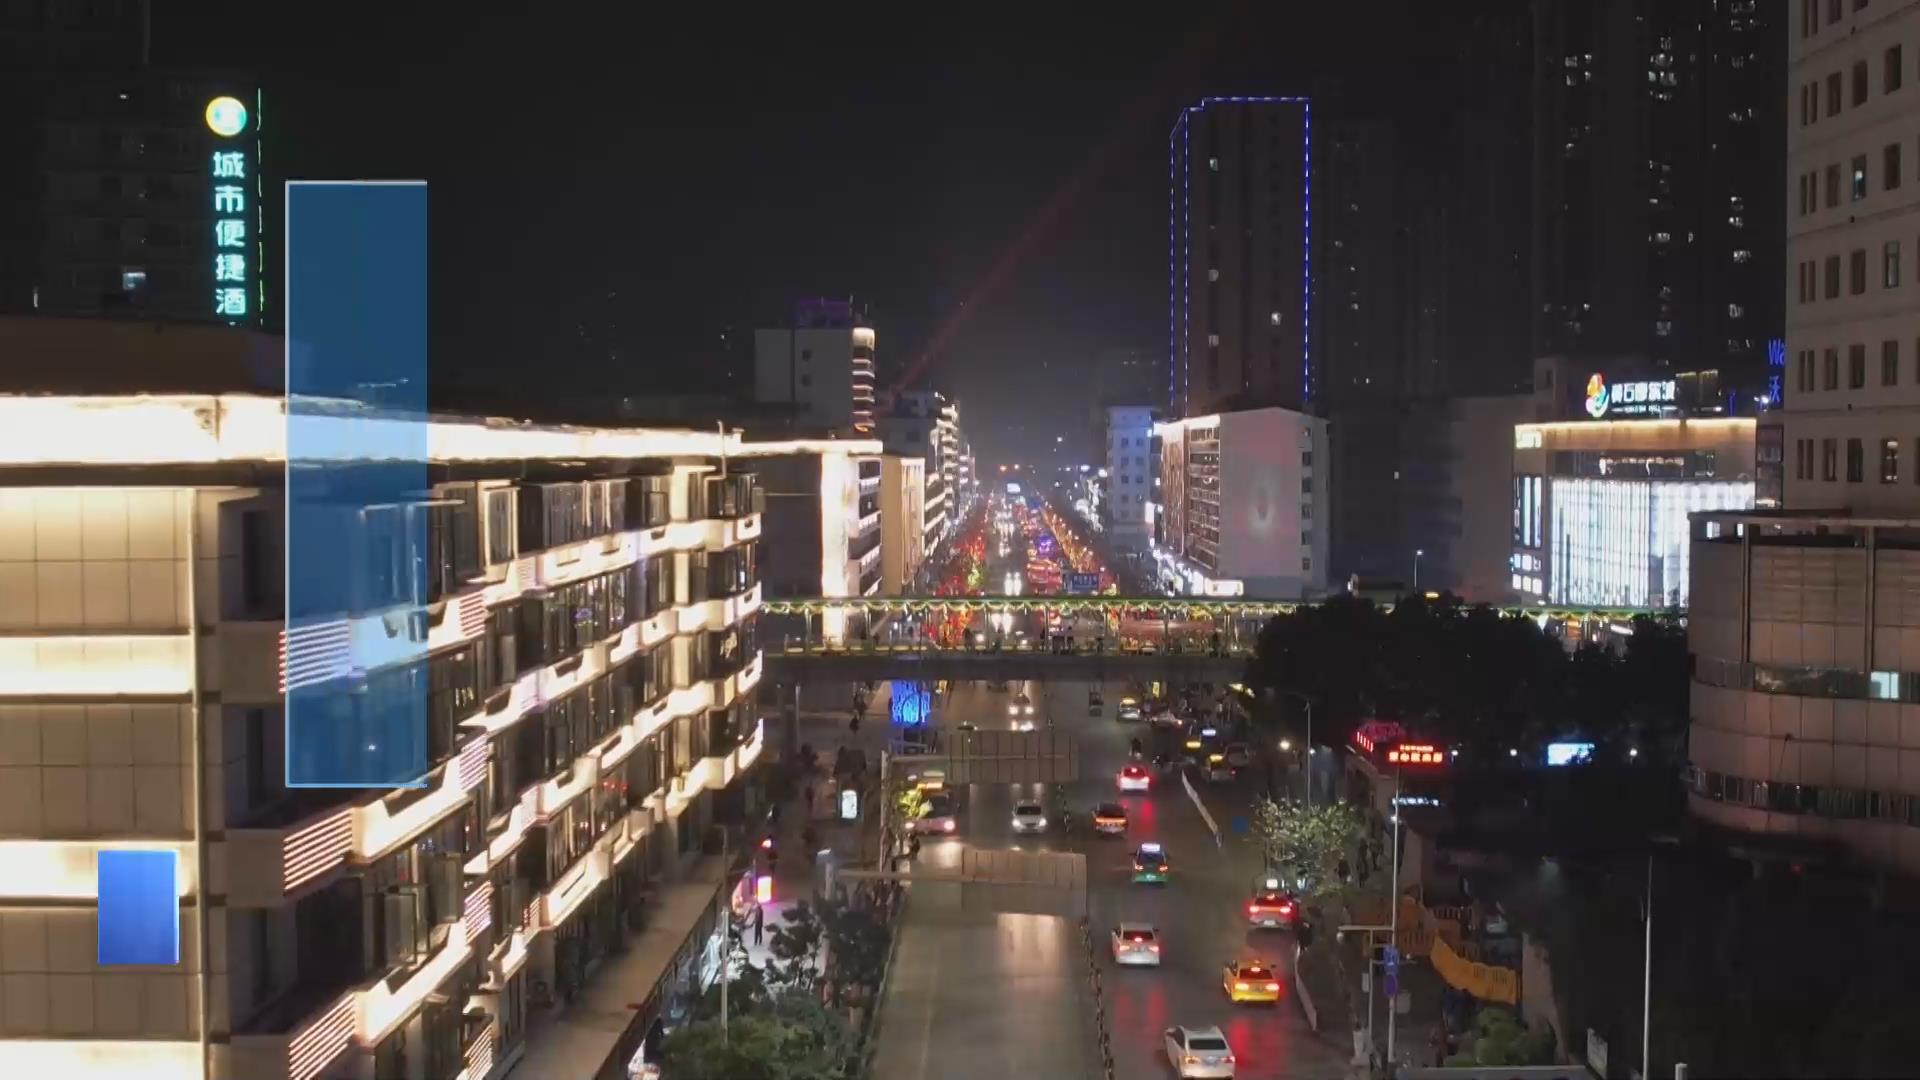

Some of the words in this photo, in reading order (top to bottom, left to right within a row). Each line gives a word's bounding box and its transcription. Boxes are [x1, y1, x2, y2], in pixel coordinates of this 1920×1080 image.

[212, 151, 247, 325] 城市便捷酒
